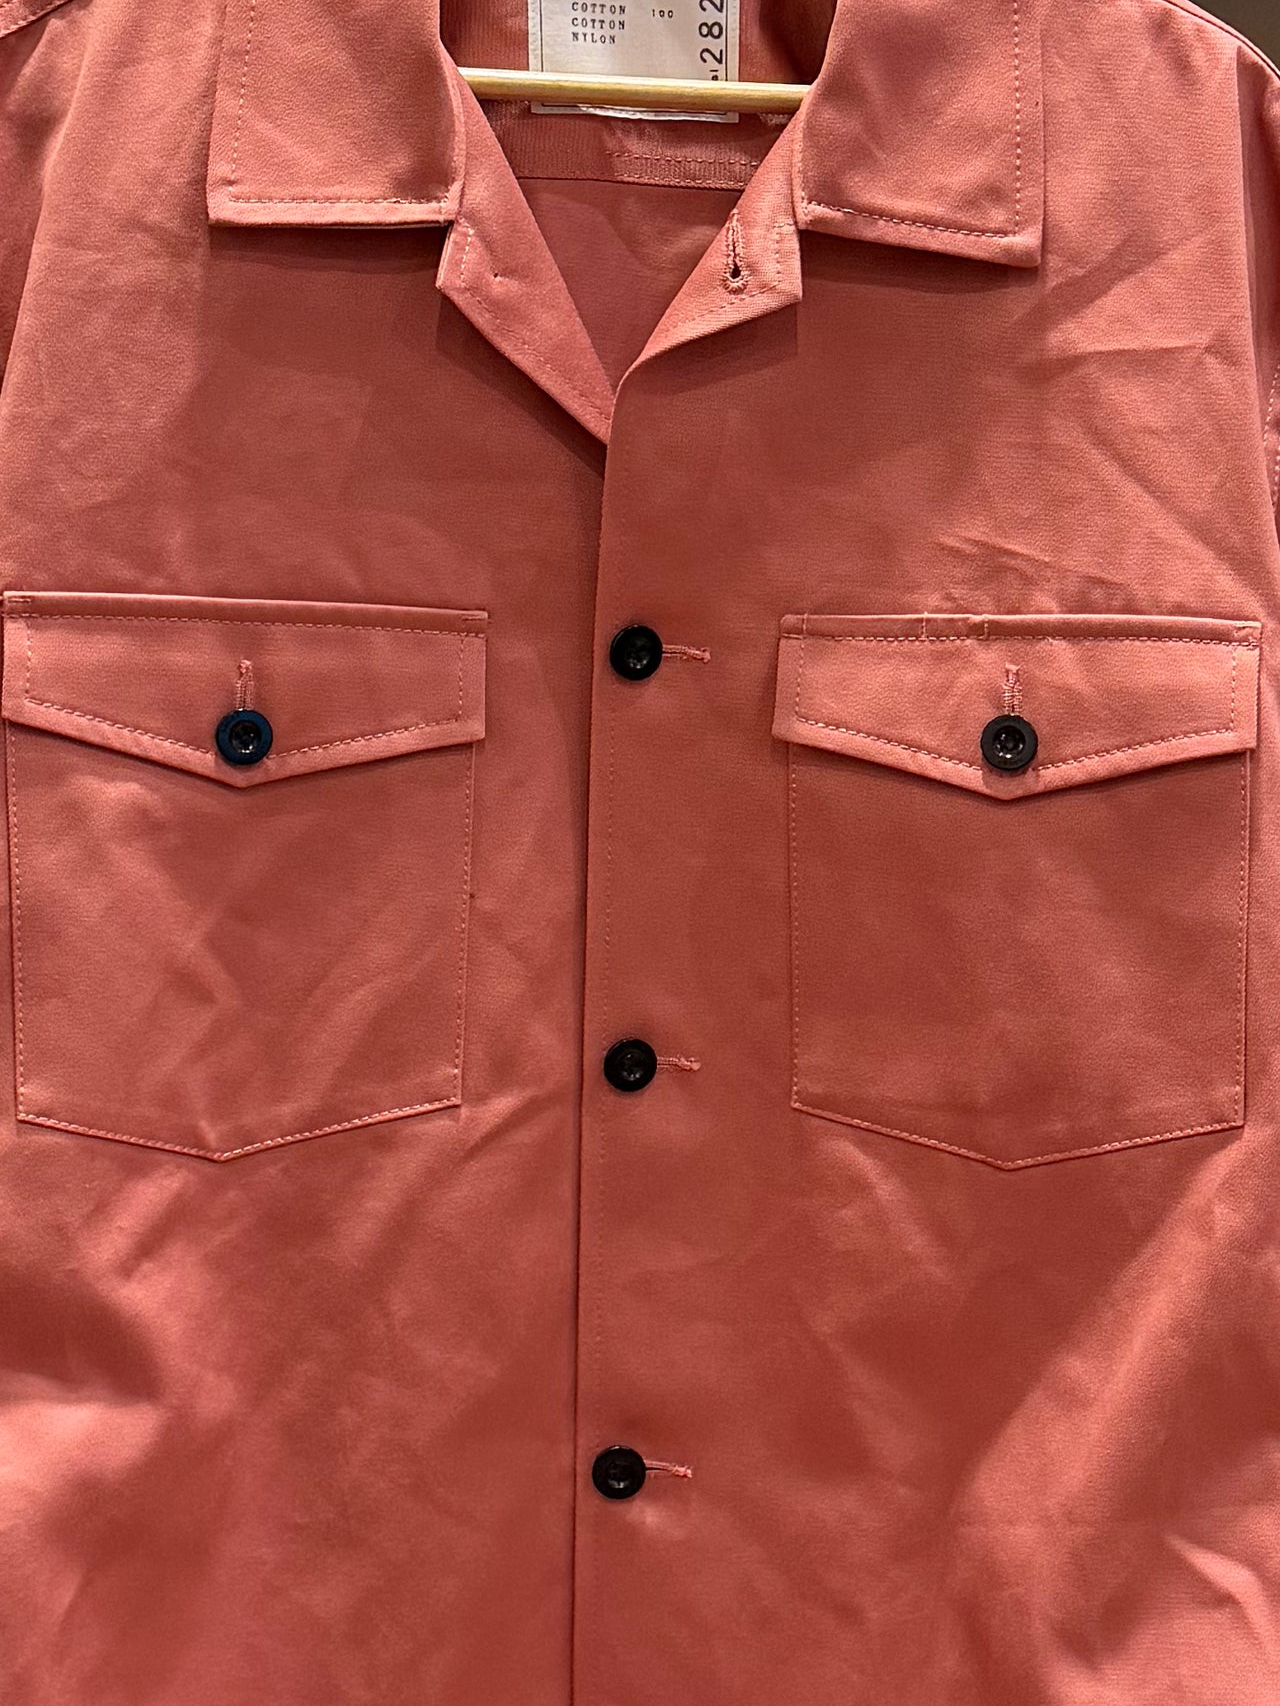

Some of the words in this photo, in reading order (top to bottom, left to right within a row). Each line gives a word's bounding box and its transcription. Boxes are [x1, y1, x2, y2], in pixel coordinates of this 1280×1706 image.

[571, 2, 626, 15] COTTON
[652, 8, 674, 19] 100
[571, 17, 626, 30] COTTON
[571, 31, 616, 44] NYLON
